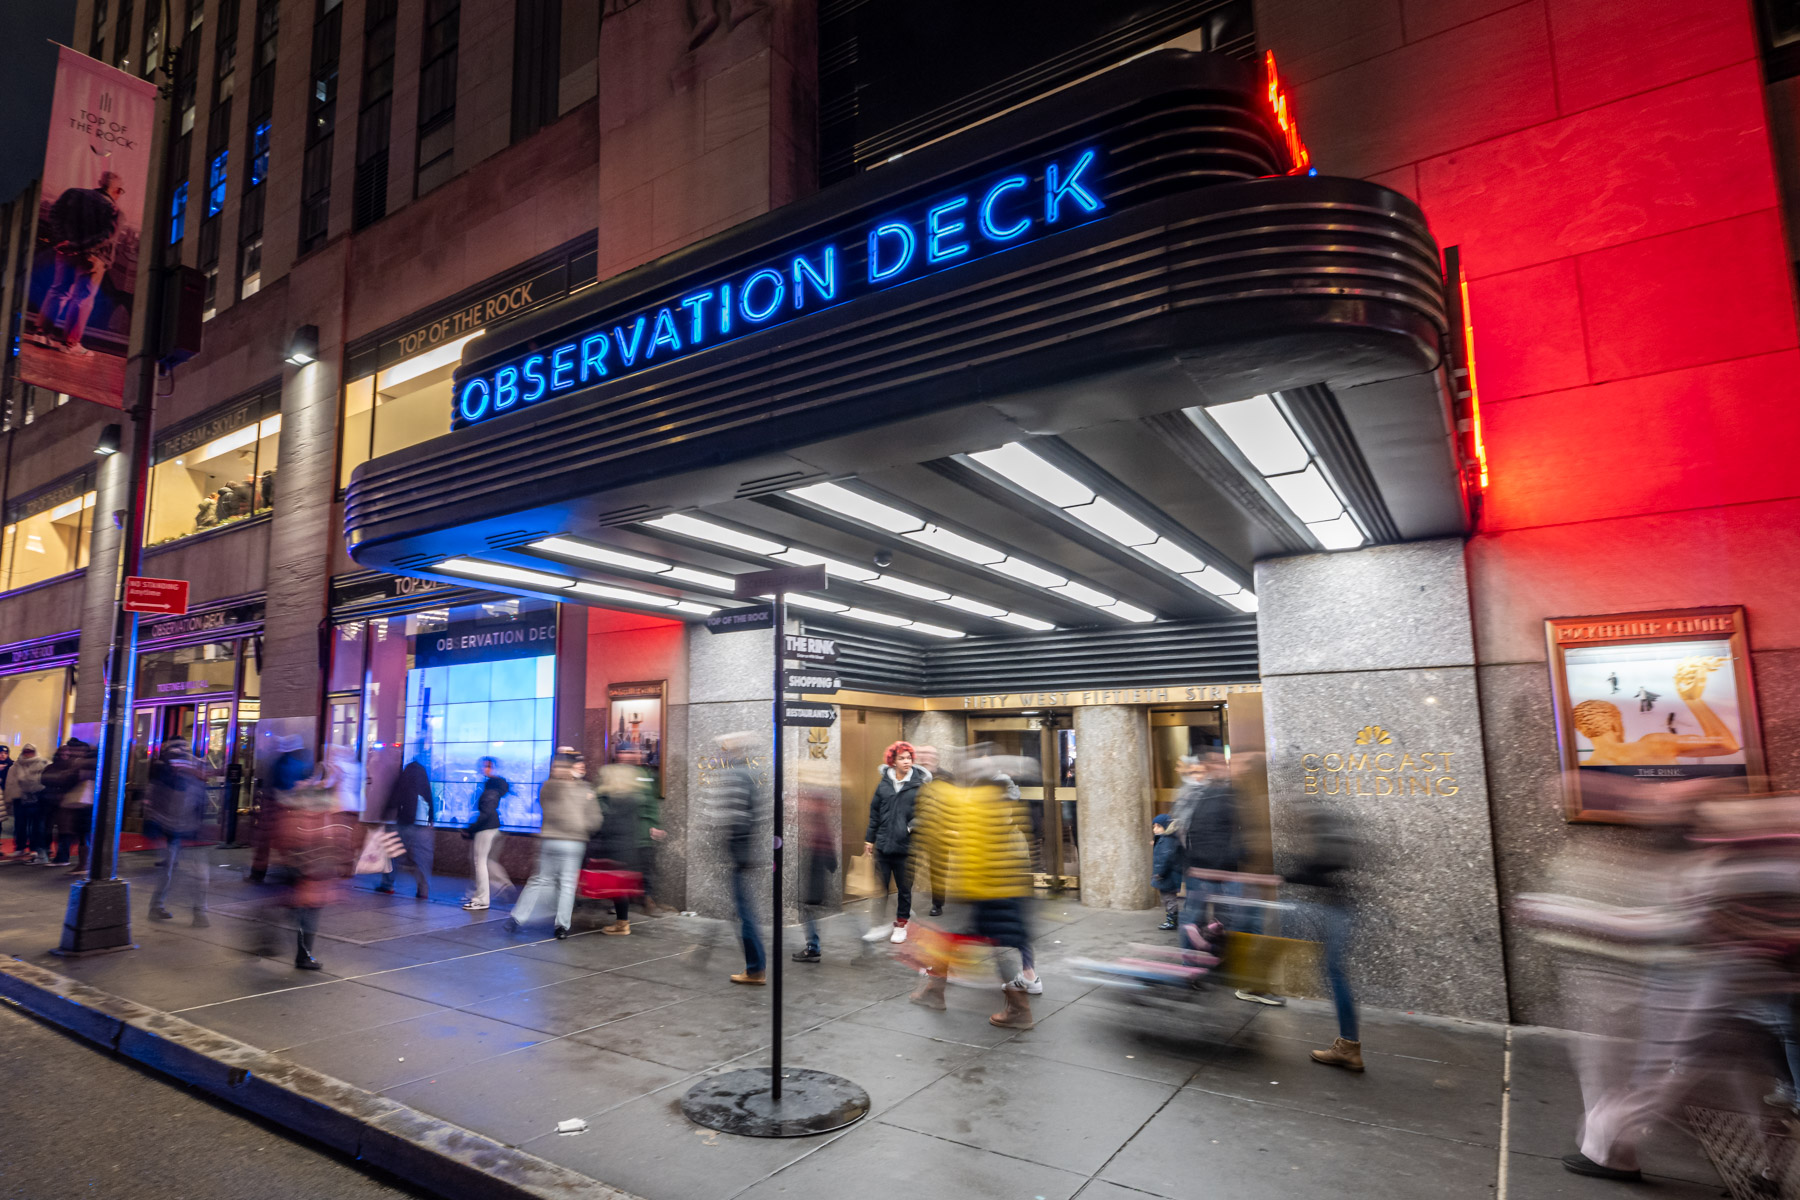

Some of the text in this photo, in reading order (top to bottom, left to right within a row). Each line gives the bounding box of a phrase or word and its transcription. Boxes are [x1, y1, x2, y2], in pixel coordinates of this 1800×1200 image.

[80, 109, 128, 134] TOP OF
[70, 118, 133, 150] THE ROCK
[460, 149, 1100, 421] OBSERVATION DECK
[398, 282, 533, 356] TOP OF THE ROCK
[129, 580, 180, 590] NO STANDING
[129, 588, 162, 596] Anytime
[394, 576, 420, 595] TOP
[151, 612, 225, 638] OBSERVATION DECK
[707, 612, 769, 626] TOP OF THE ROCK
[436, 629, 524, 651] OBSERVATION
[785, 636, 835, 655] THE RINK
[788, 675, 833, 688] SHOPPING
[964, 694, 1008, 709] FIFTY
[1020, 692, 1069, 706] WEST
[1083, 689, 1168, 704] FIFTIETH
[785, 707, 829, 719] RESTAURANTS
[698, 756, 767, 770] COMAST
[1302, 752, 1455, 773] COMCAST
[1304, 776, 1459, 797] BUILDING
